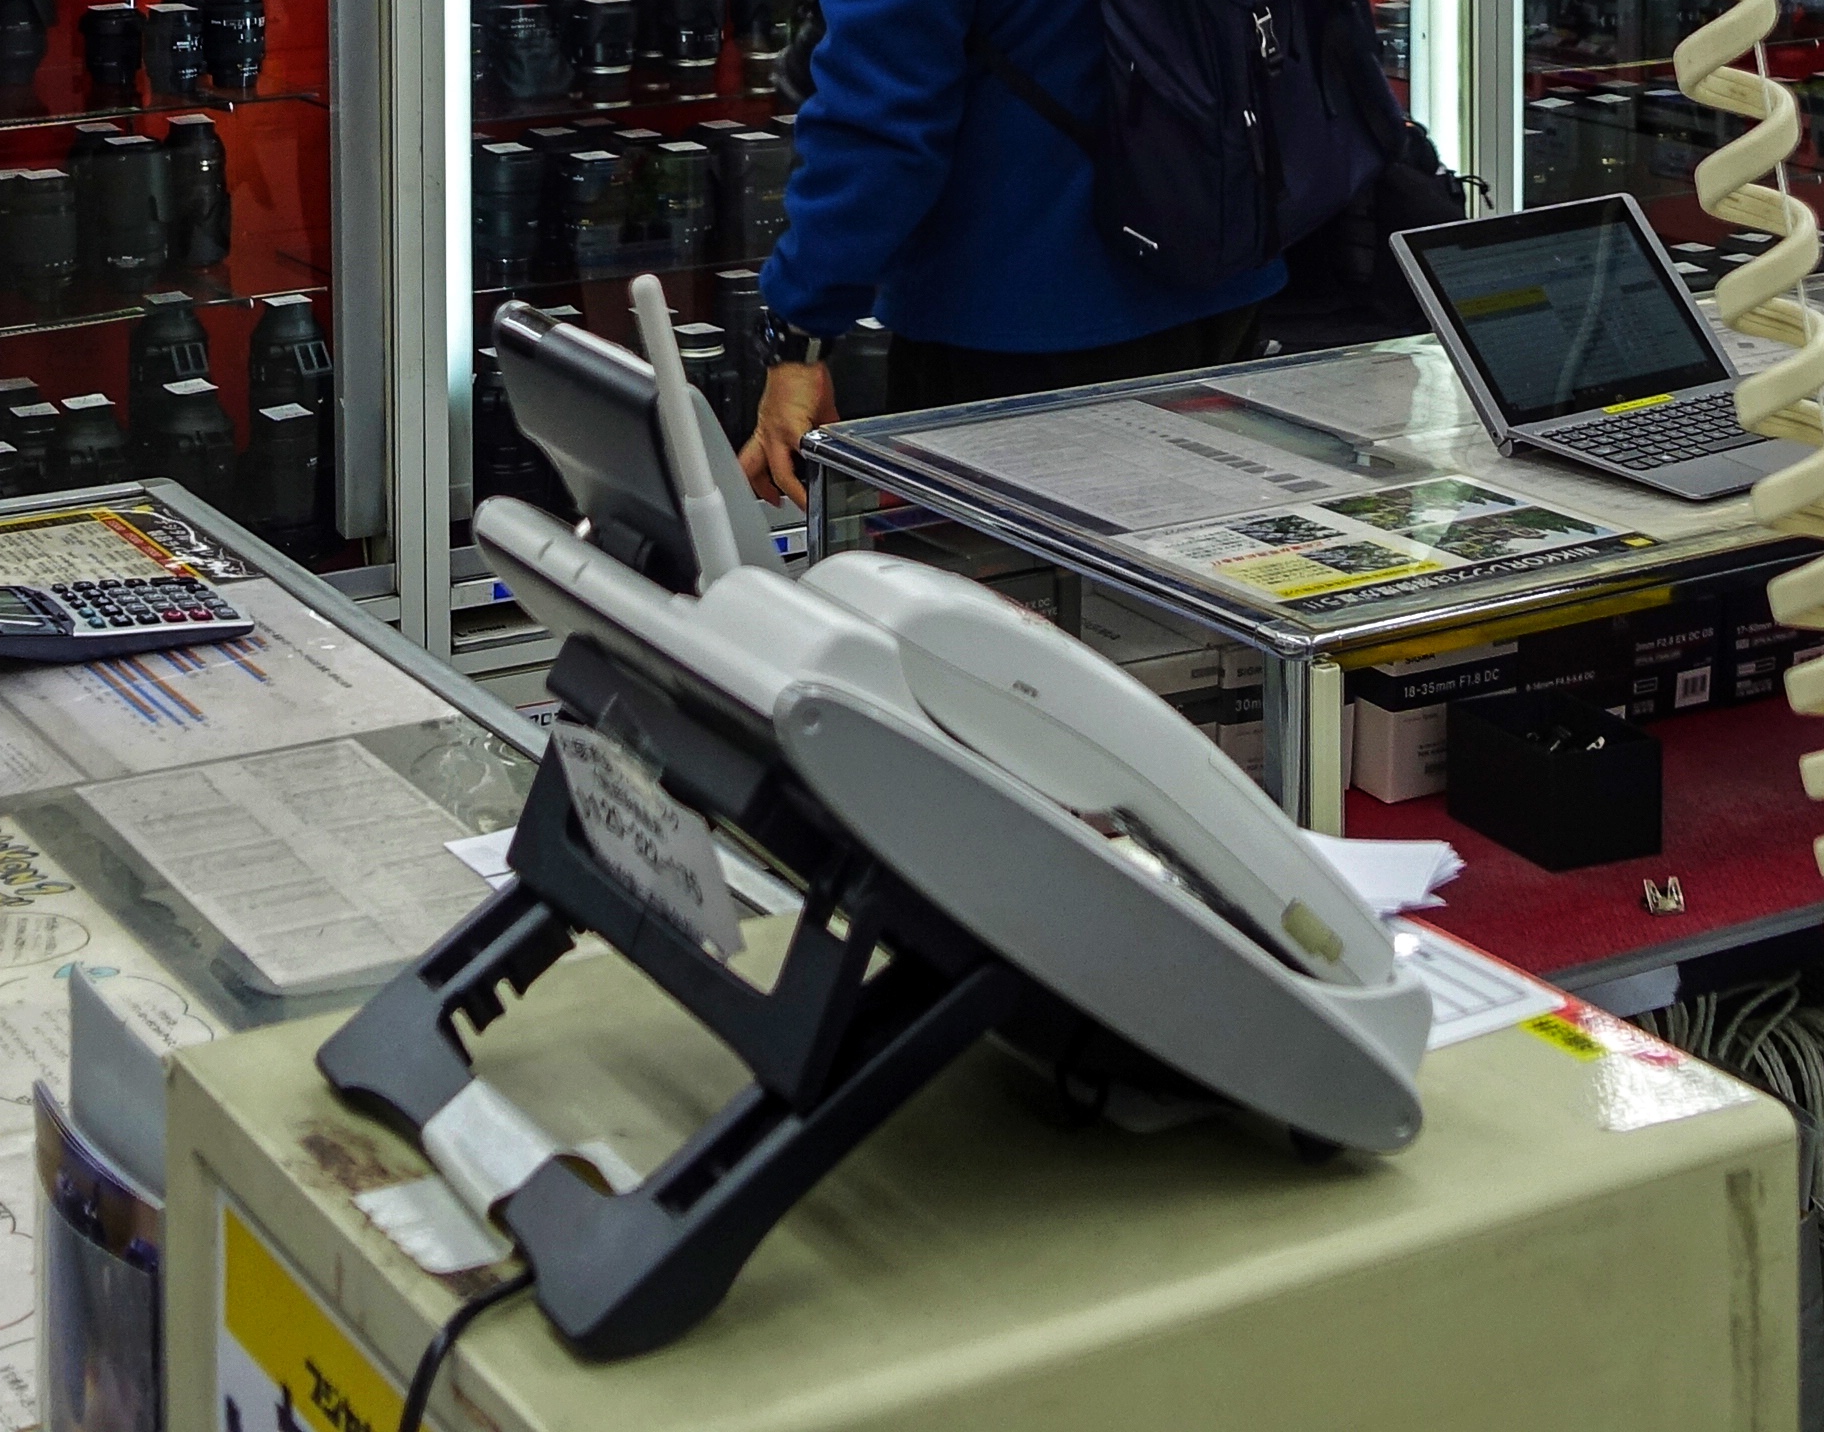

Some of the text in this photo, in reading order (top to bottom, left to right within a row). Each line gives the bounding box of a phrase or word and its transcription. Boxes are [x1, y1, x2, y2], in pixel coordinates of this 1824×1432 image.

[1403, 668, 1500, 699] 18-35mm F1.8 DC
